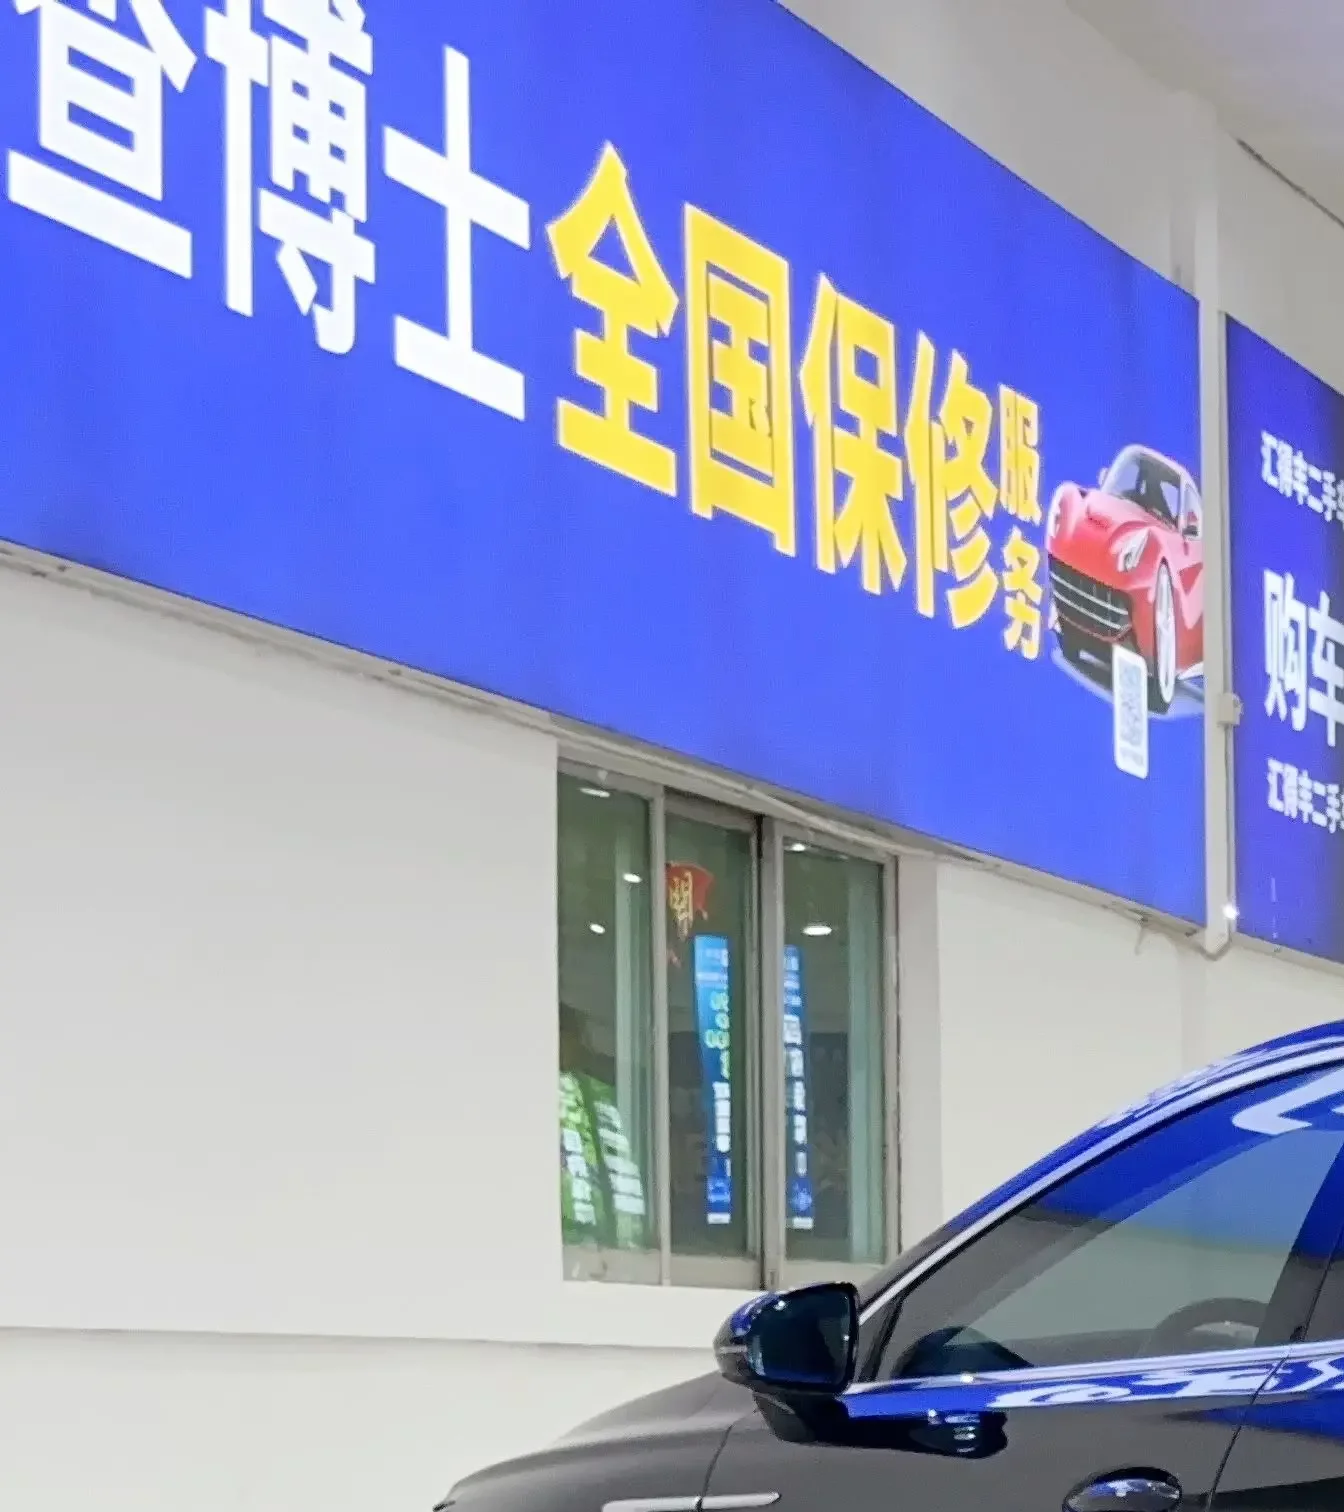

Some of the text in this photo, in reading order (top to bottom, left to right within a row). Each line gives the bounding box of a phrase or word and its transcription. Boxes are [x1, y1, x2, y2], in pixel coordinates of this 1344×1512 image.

[547, 142, 1000, 630] 全国保修
[999, 384, 1043, 661] 服务
